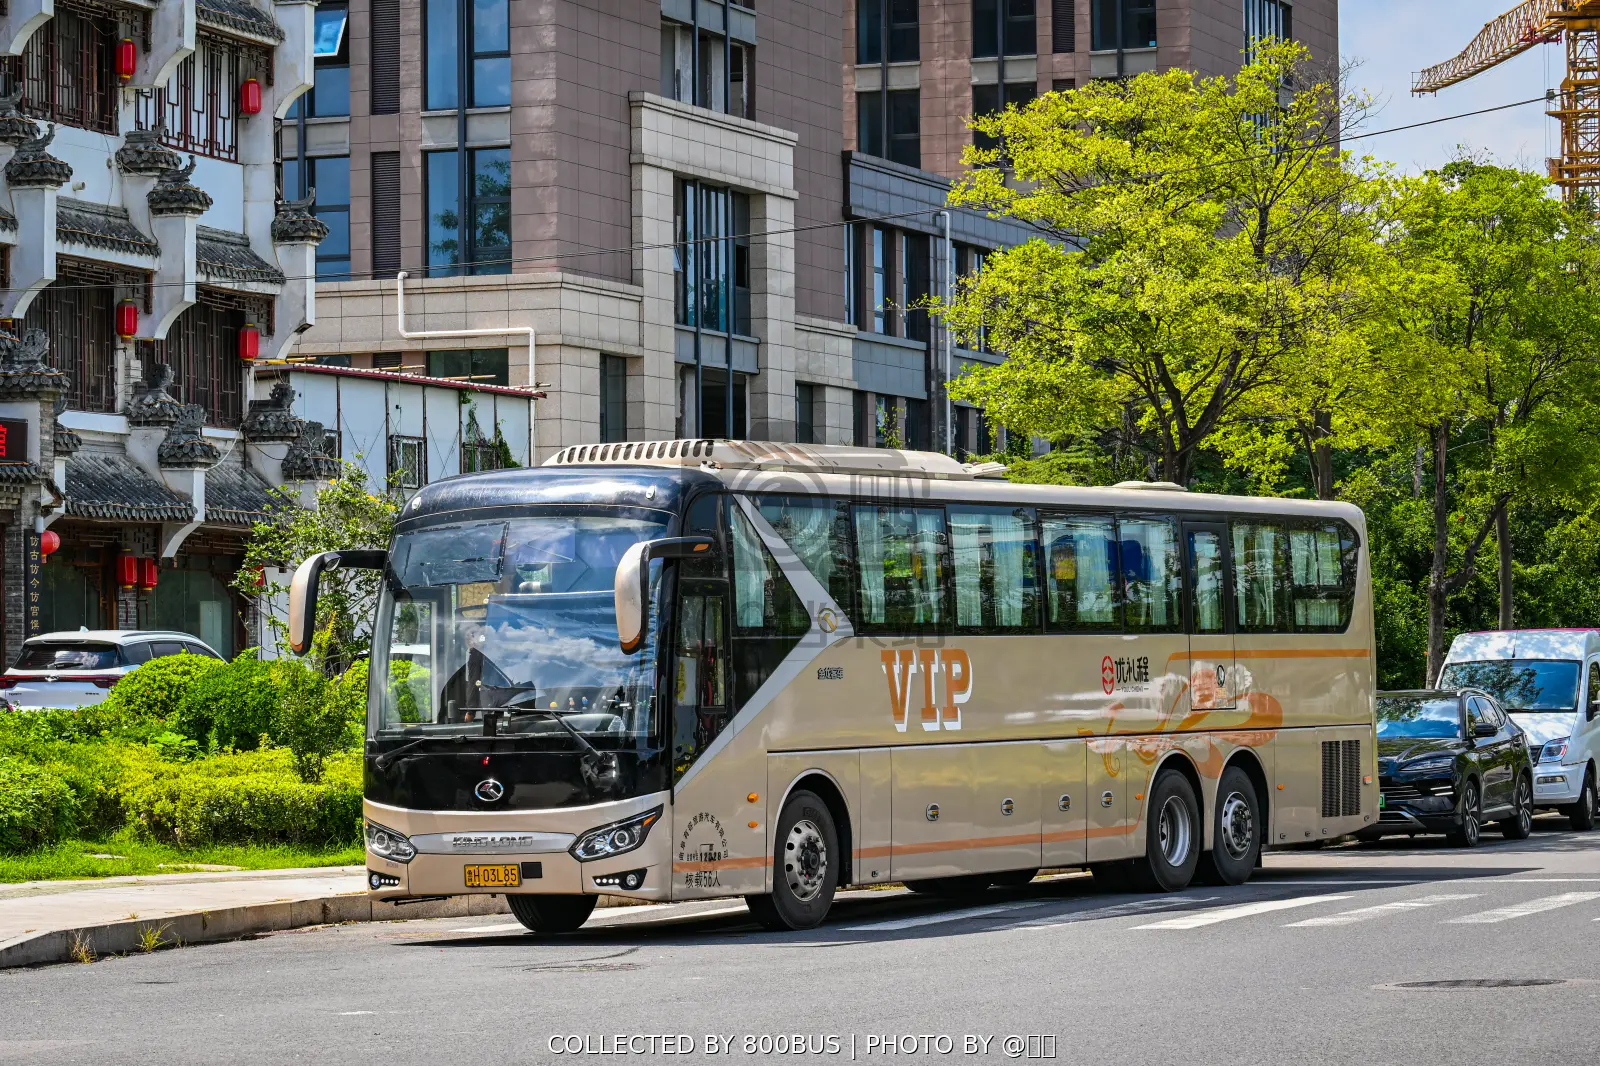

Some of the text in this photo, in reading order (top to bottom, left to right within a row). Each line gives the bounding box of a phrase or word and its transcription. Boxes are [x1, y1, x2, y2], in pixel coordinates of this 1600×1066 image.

[881, 648, 973, 733] VIP
[452, 835, 533, 848] KING LONG
[685, 869, 721, 889] 核载56人
